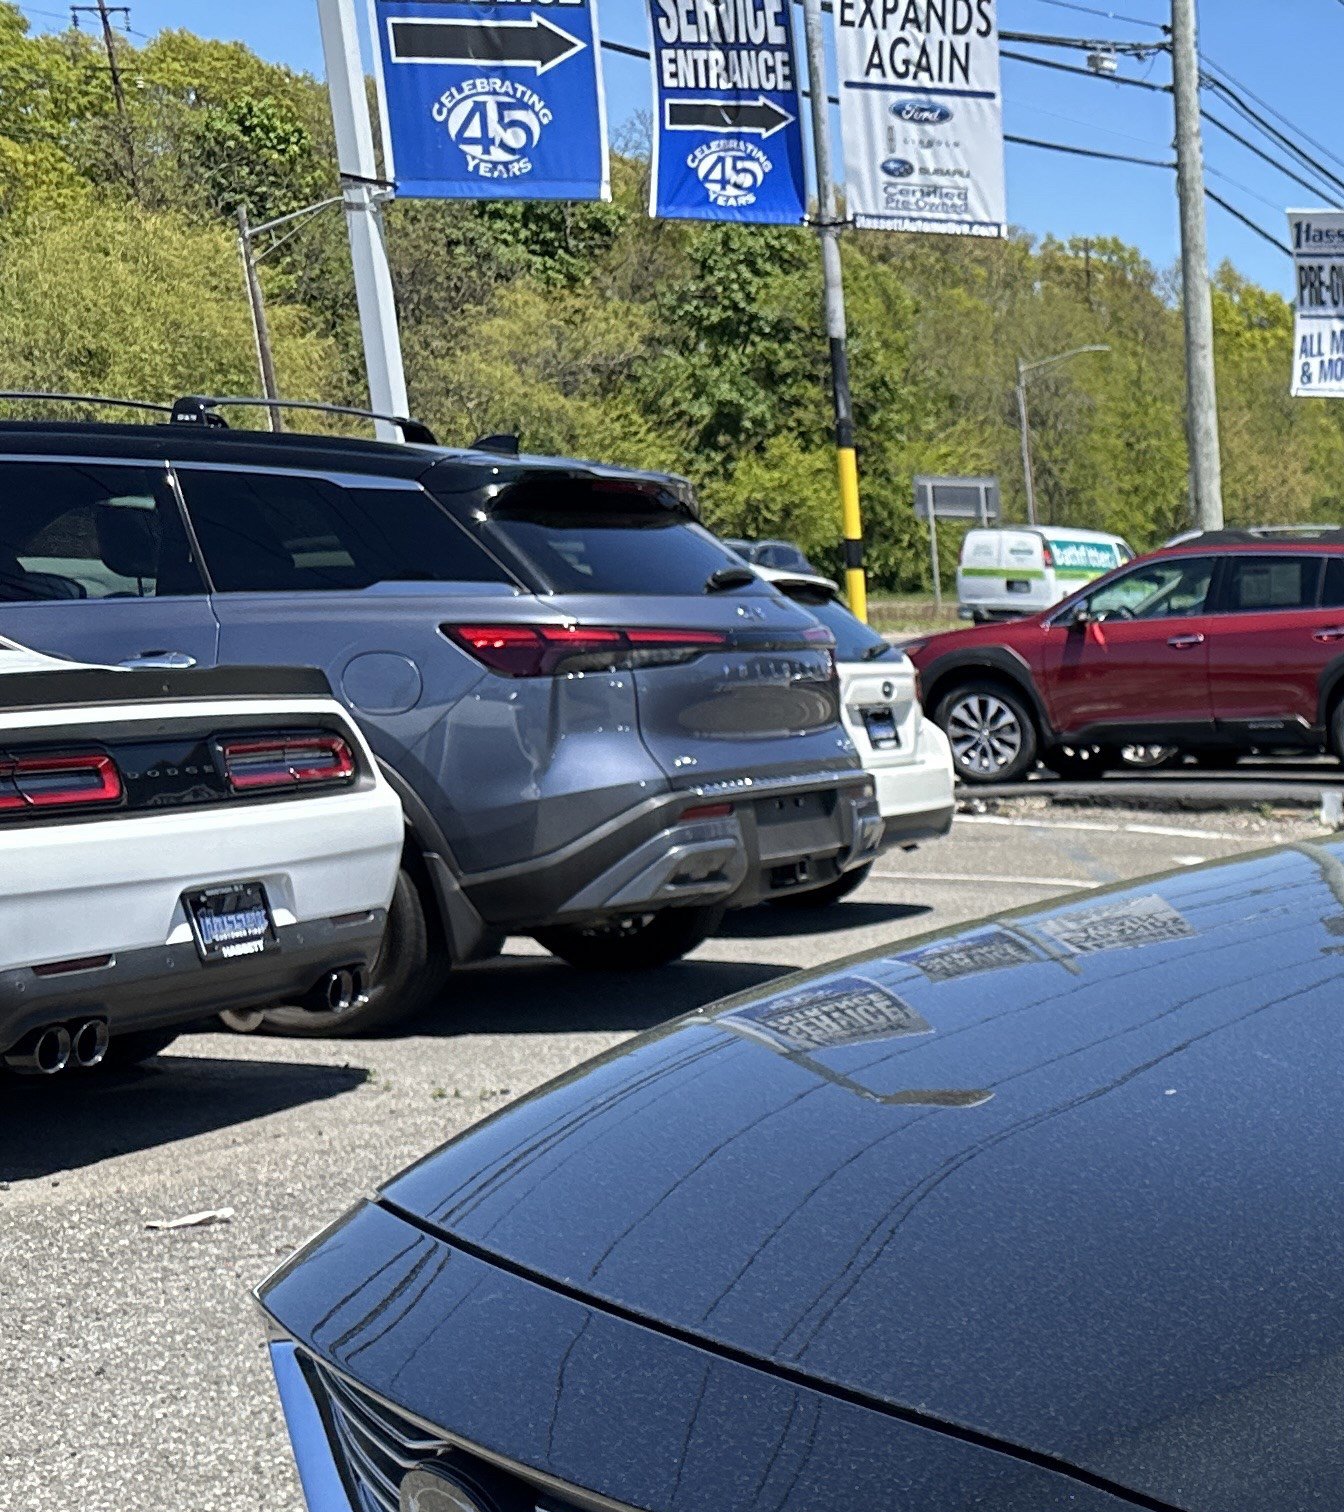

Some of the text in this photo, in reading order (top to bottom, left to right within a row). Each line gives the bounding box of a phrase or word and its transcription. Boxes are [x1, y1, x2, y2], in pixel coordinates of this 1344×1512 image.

[657, 0, 787, 45] SERVICE
[839, 0, 992, 38] EXPANDS
[661, 49, 793, 91] ENTRANCE
[864, 35, 970, 85] AGAIN
[431, 78, 554, 125] CELEBRATING
[465, 155, 533, 179] YEARS
[687, 139, 773, 173] CELEBRATING
[708, 189, 756, 207] YEARS
[1299, 334, 1325, 360] ALL
[1300, 361, 1313, 386] &
